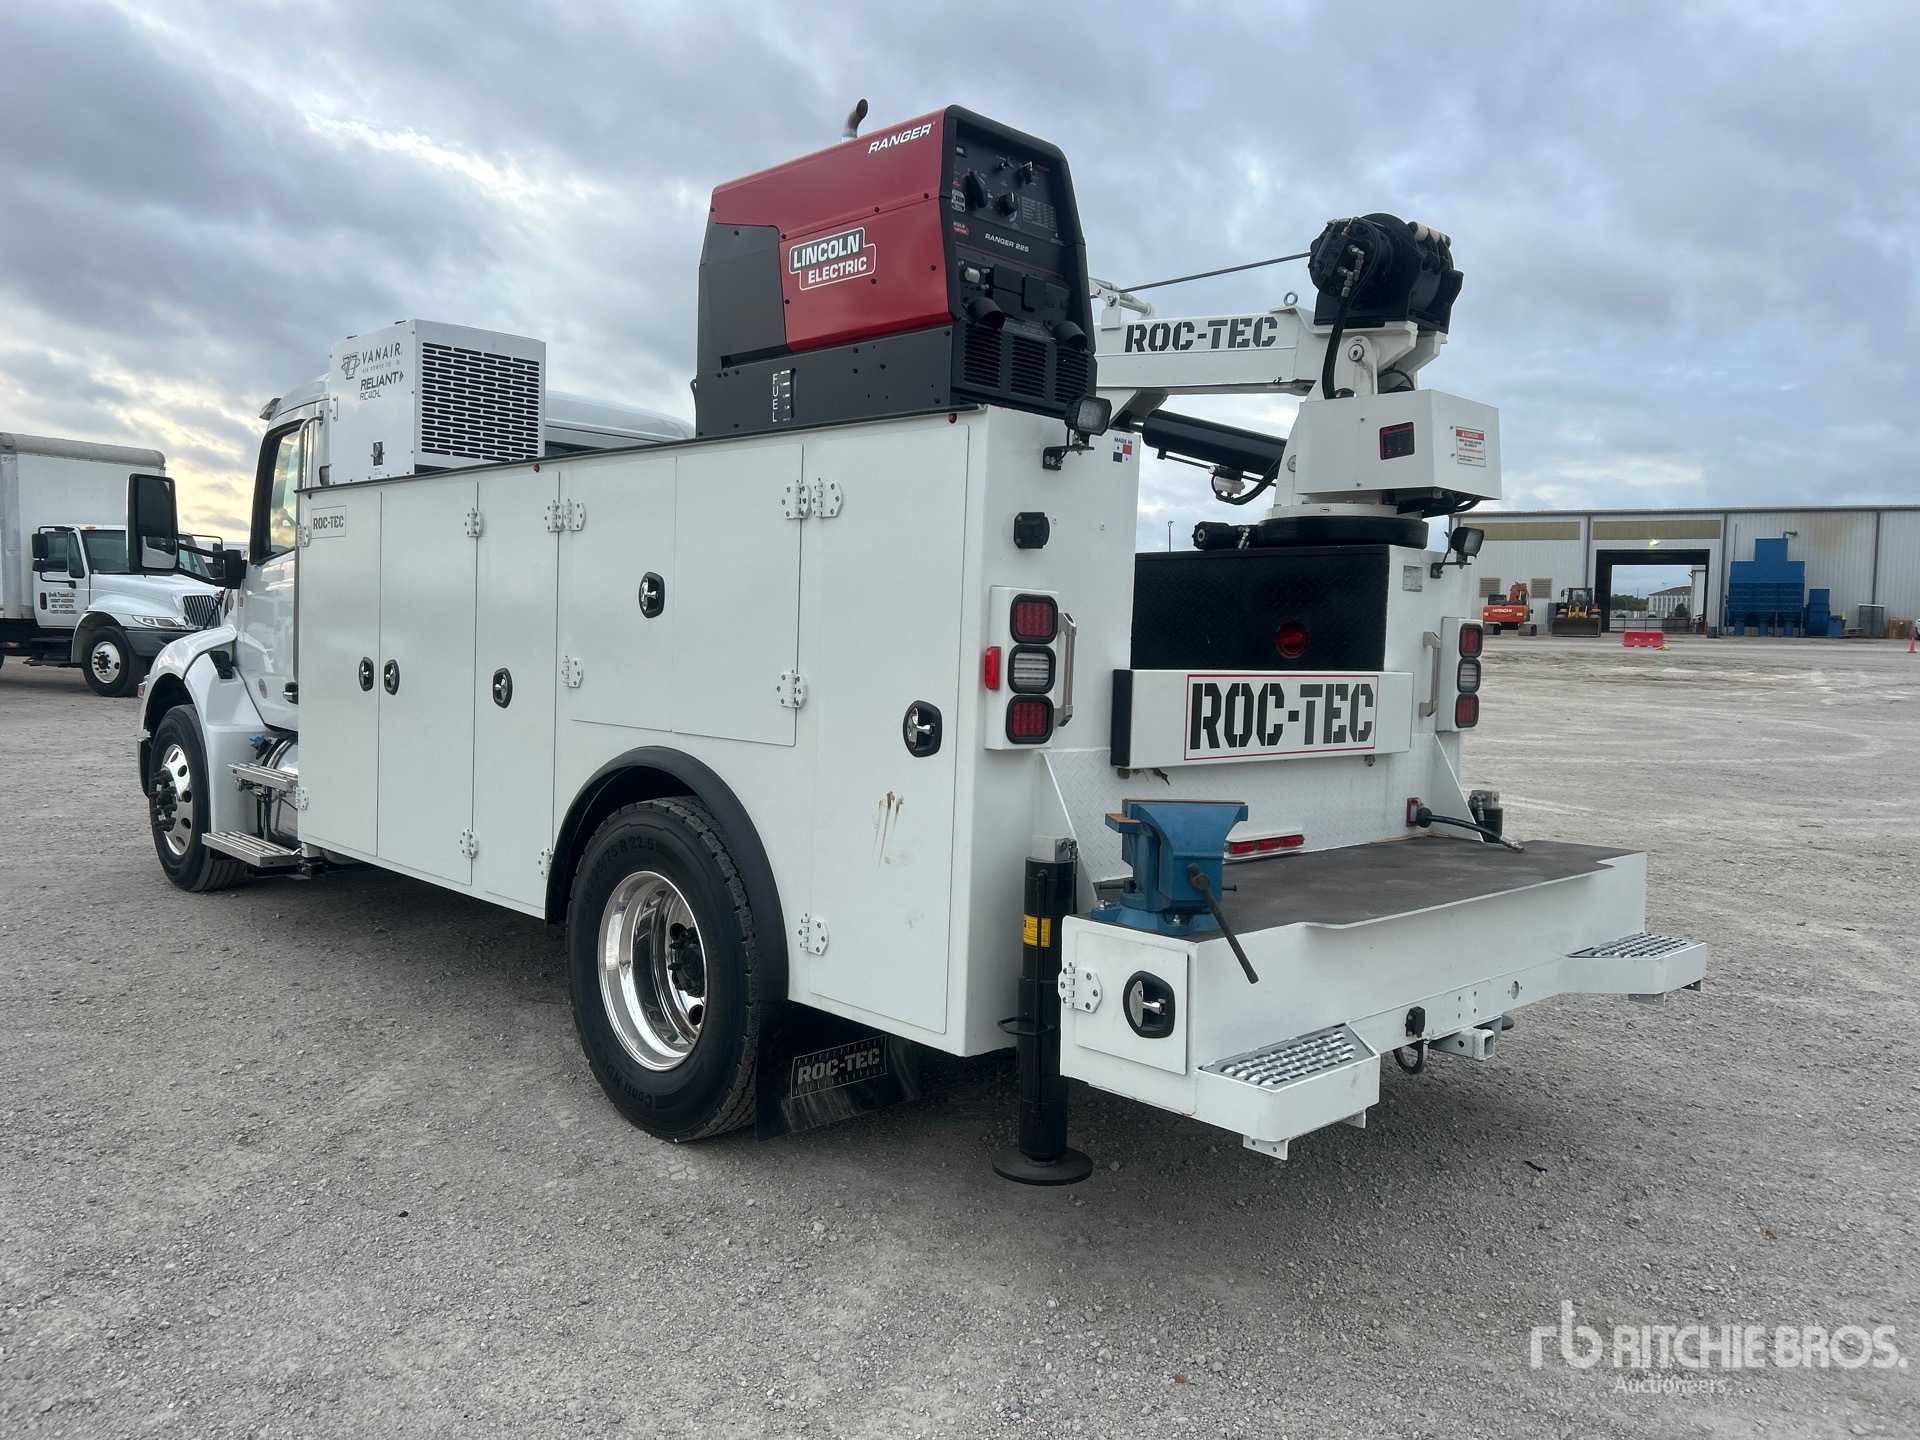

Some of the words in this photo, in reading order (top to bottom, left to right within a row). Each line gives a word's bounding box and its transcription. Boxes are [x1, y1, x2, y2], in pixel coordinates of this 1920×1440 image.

[868, 123, 932, 154] RANGER
[793, 233, 859, 269] LINCOLN
[984, 233, 1014, 248] RANGER
[1015, 243, 1030, 253] 225
[808, 256, 867, 284] ELECTRIC
[1124, 316, 1278, 352] ROC-TEC
[362, 342, 401, 365] VANAIR
[360, 370, 400, 391] RELIANT
[312, 515, 344, 530] ROC-TEC
[1189, 682, 1374, 750] ROC-TEC
[617, 838, 628, 853] R
[628, 835, 654, 851] 22.5
[797, 1047, 880, 1085] ROC-TEC
